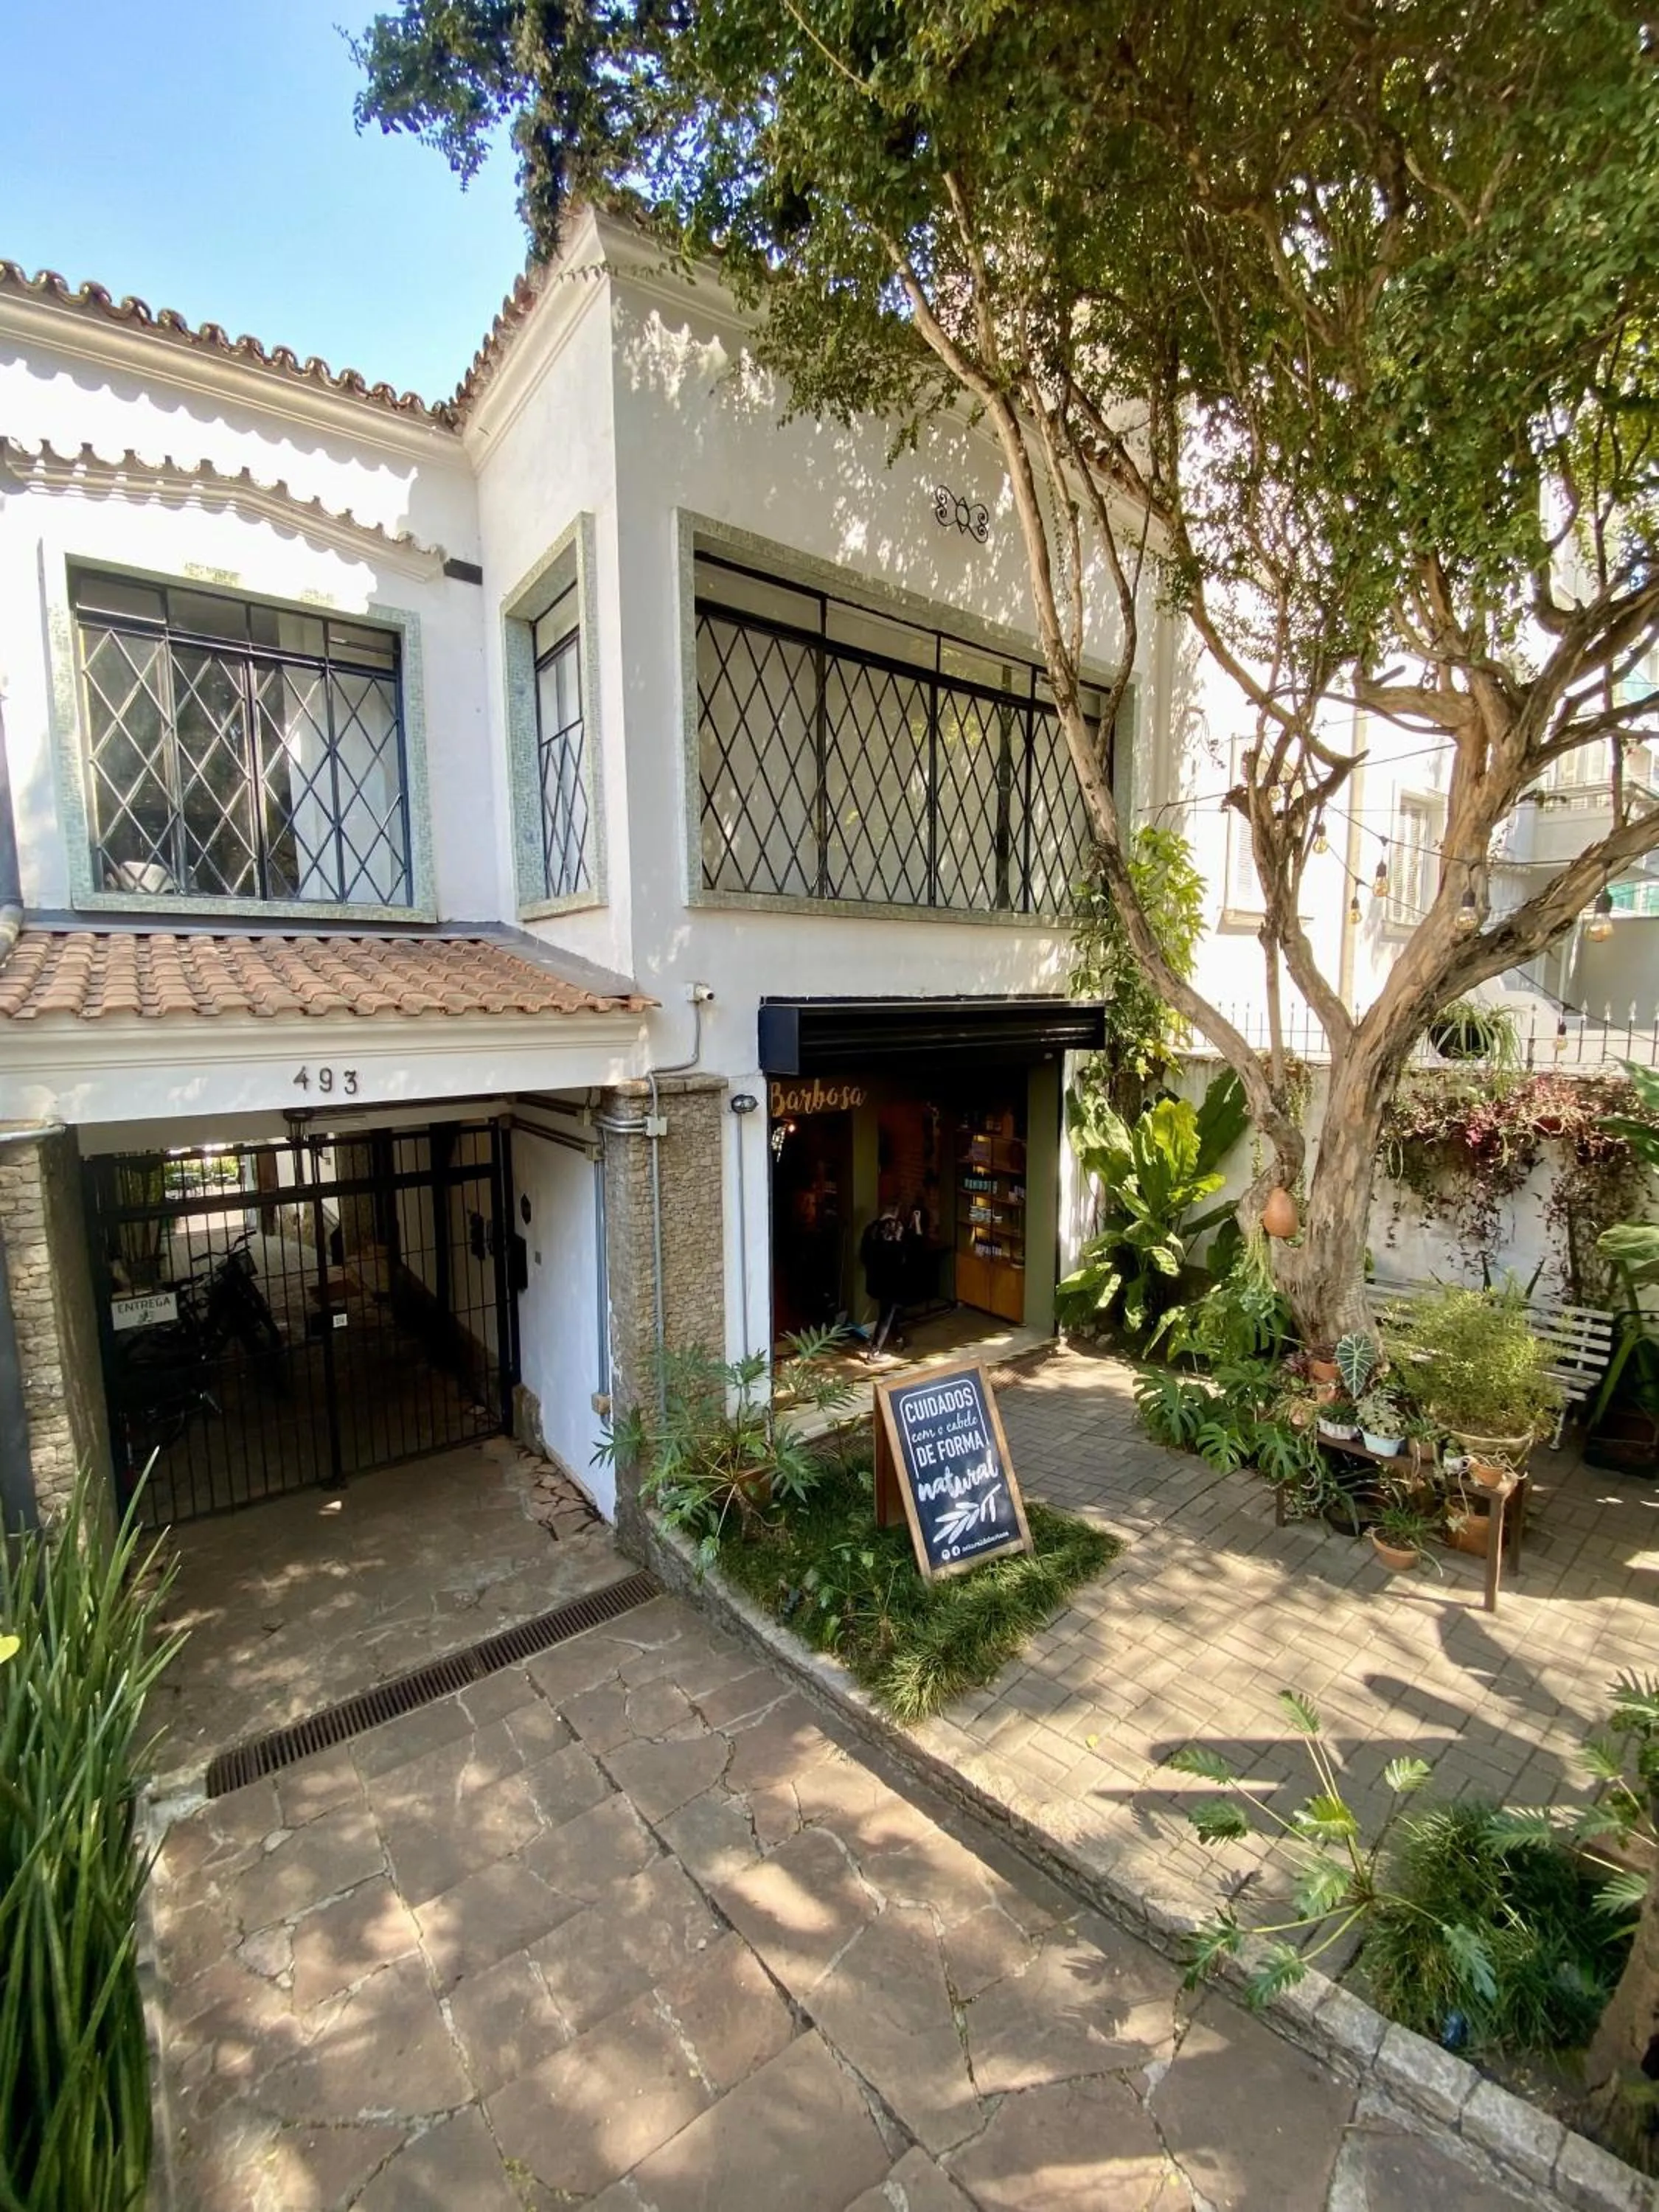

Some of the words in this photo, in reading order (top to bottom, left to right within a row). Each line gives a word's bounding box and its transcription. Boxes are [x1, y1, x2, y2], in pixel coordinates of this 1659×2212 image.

[293, 1065, 358, 1095] 493
[771, 1078, 867, 1118] Barbosa
[118, 1296, 170, 1313] ENTREGA
[905, 1387, 973, 1423] CUIDADOS
[911, 1429, 936, 1443] com
[937, 1427, 943, 1436] o
[946, 1410, 978, 1433] cabelo
[916, 1444, 936, 1467] DE
[936, 1430, 984, 1461] FORMA
[918, 1449, 998, 1502] natural
